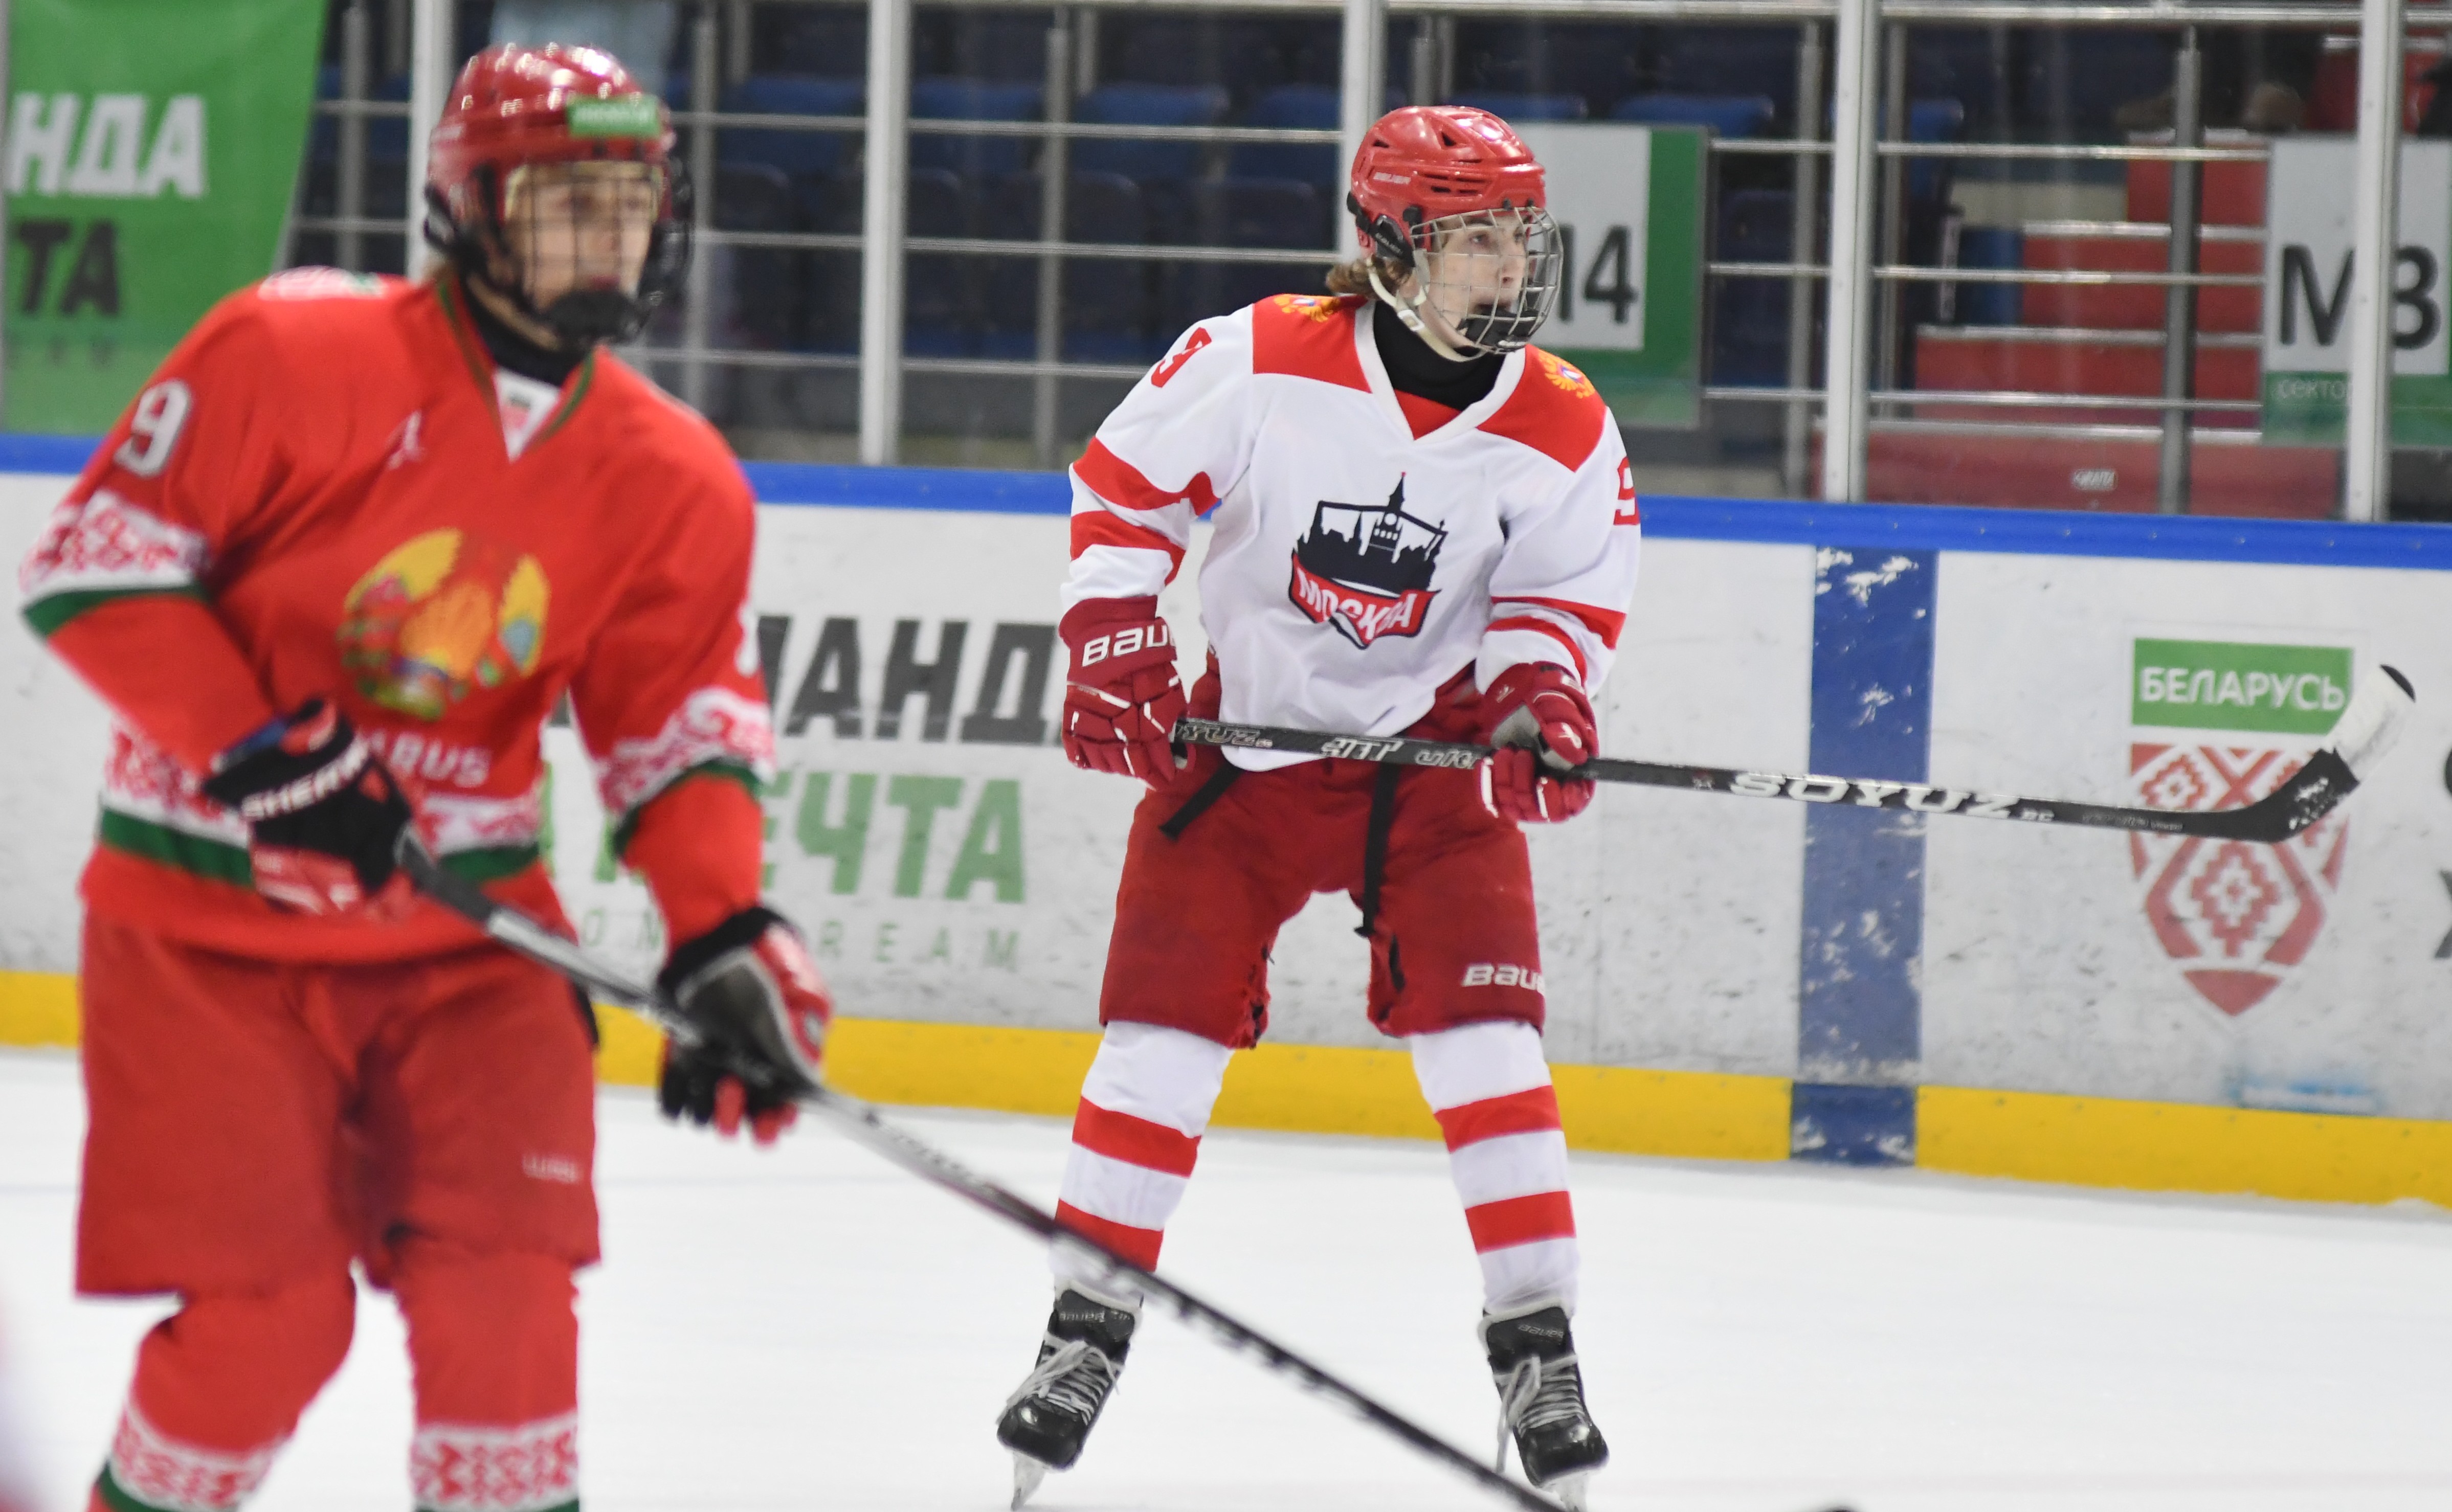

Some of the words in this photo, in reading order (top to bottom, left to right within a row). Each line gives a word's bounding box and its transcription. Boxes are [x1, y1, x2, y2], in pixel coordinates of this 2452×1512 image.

[114, 379, 191, 479] 9
[757, 614, 1066, 748] АНД
[2141, 666, 2347, 711] БЕЛАРУСЬ
[1730, 770, 2019, 818] SOYUZ
